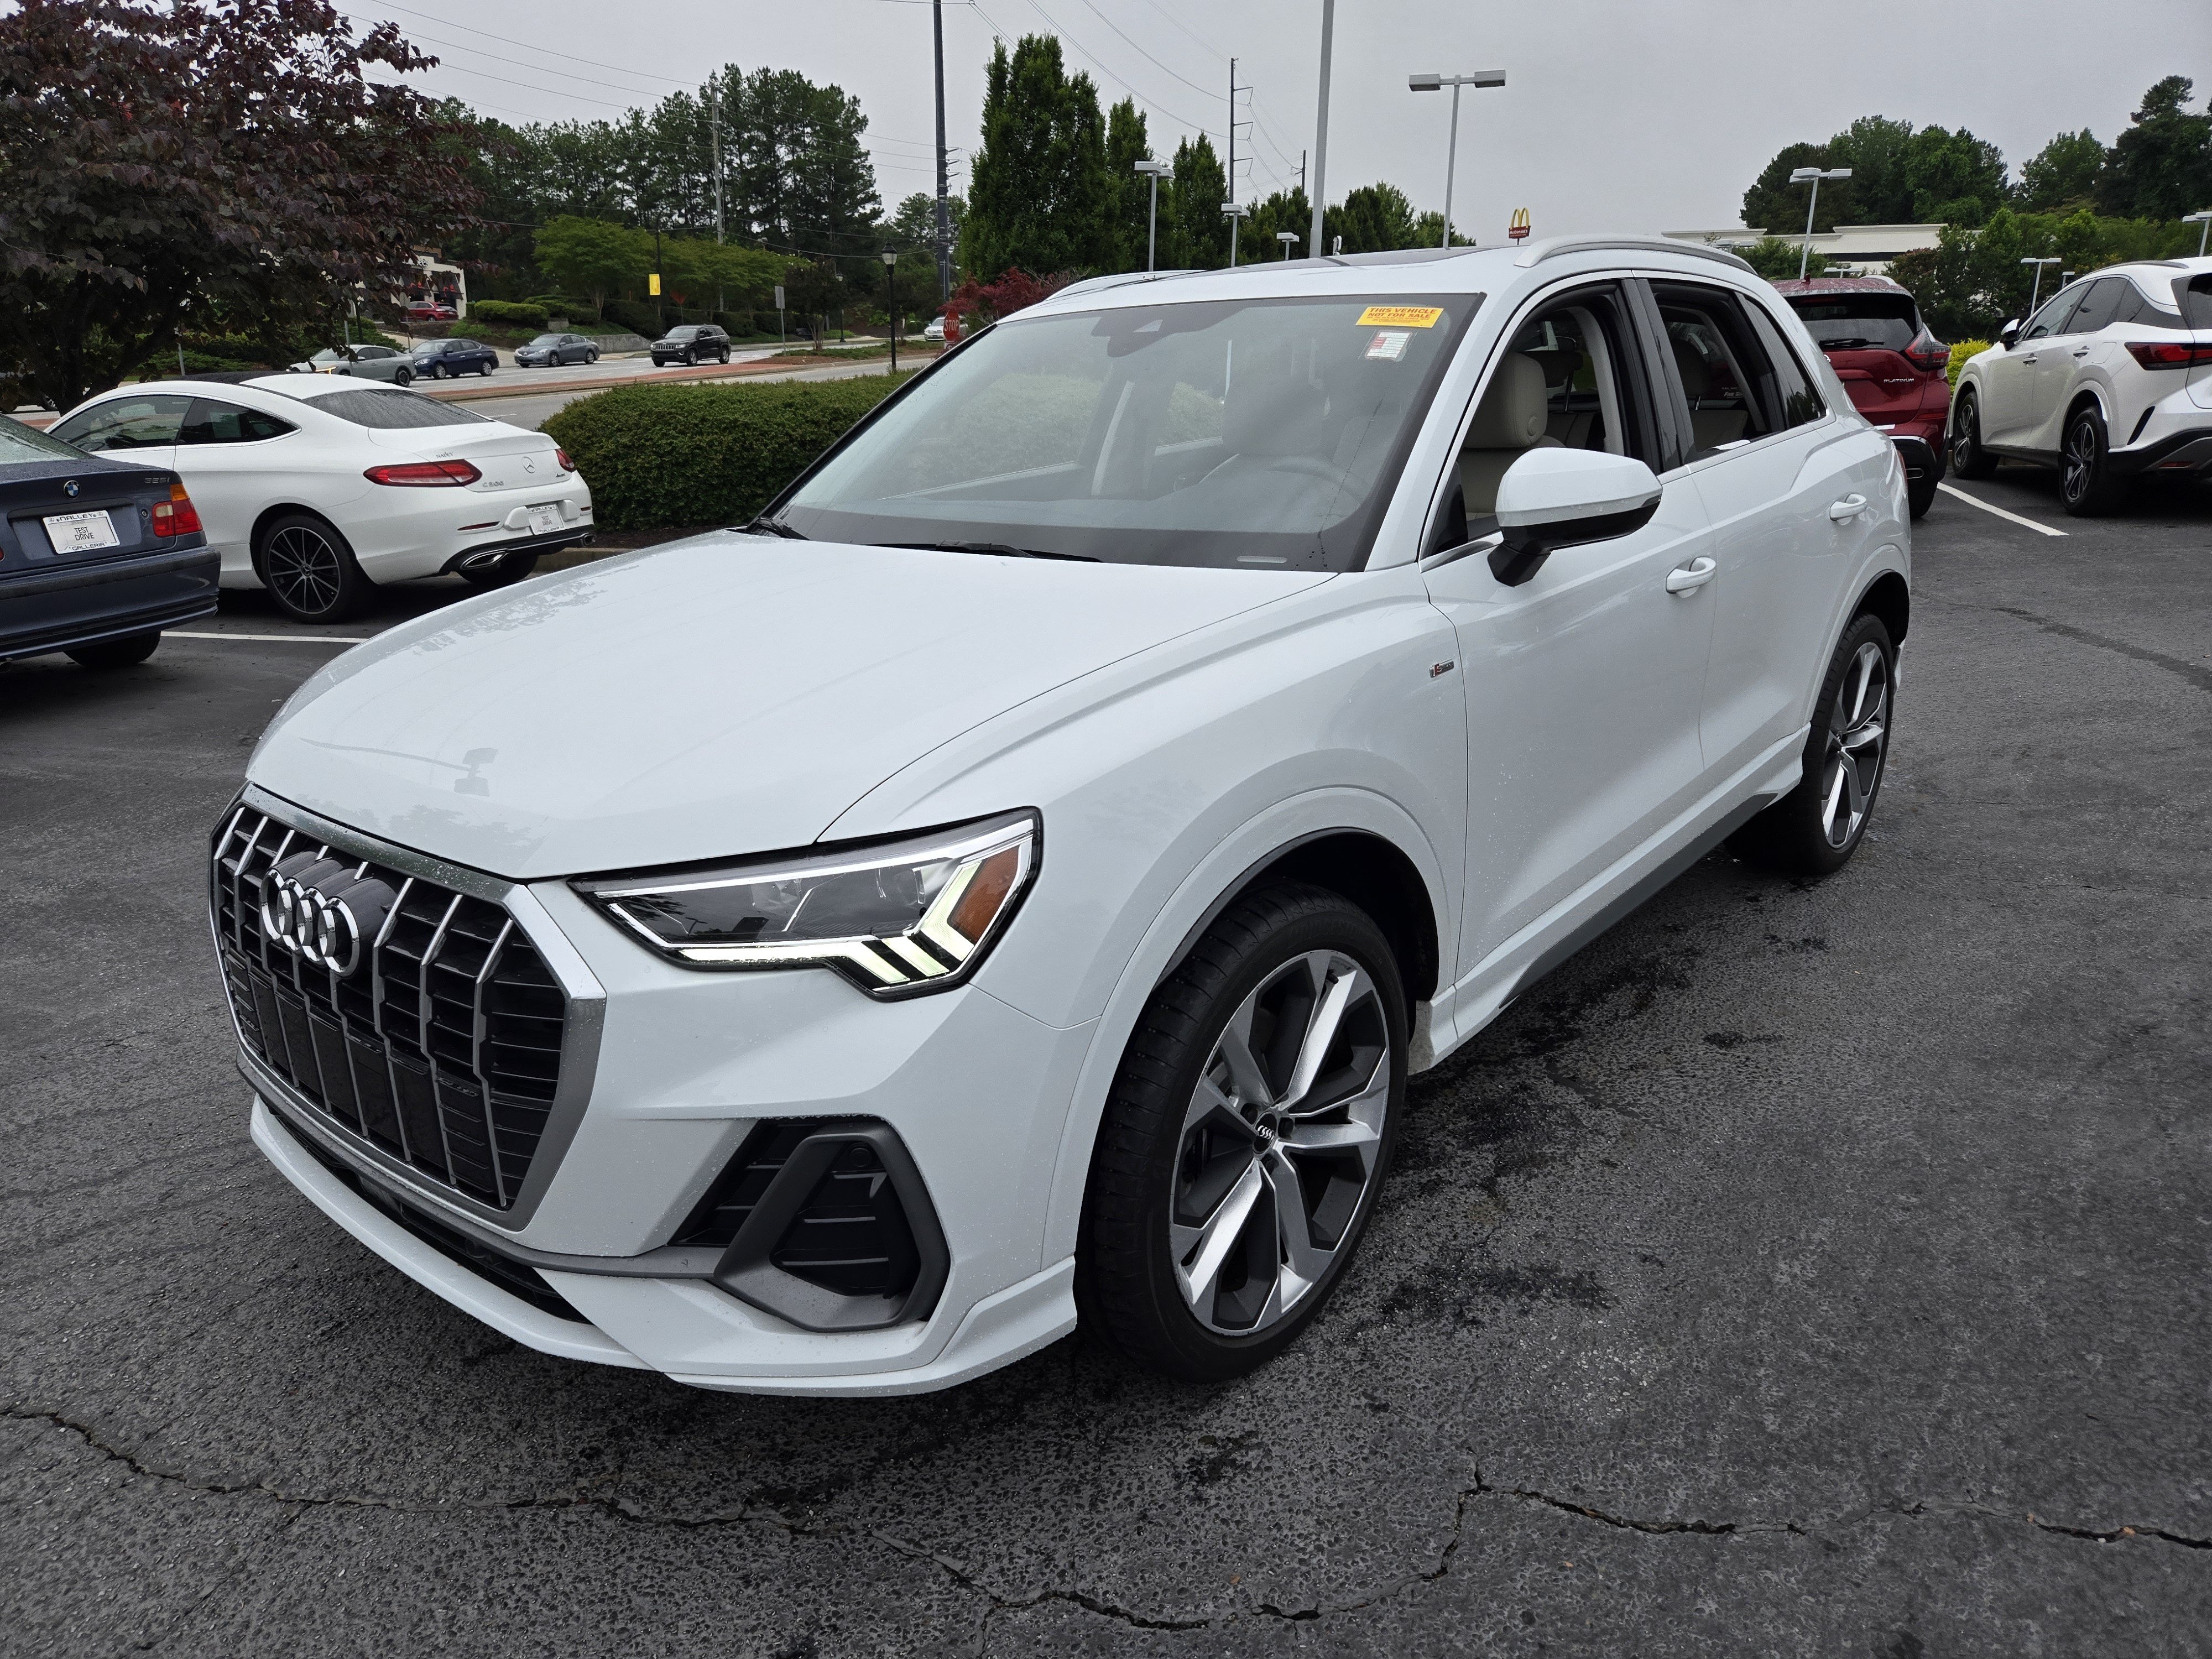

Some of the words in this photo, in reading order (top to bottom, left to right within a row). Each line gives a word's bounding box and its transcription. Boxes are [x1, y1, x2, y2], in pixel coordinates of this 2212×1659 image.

[944, 320, 959, 331] STOP
[75, 533, 95, 541] DRIVE
[72, 542, 105, 551] GALLERIA
